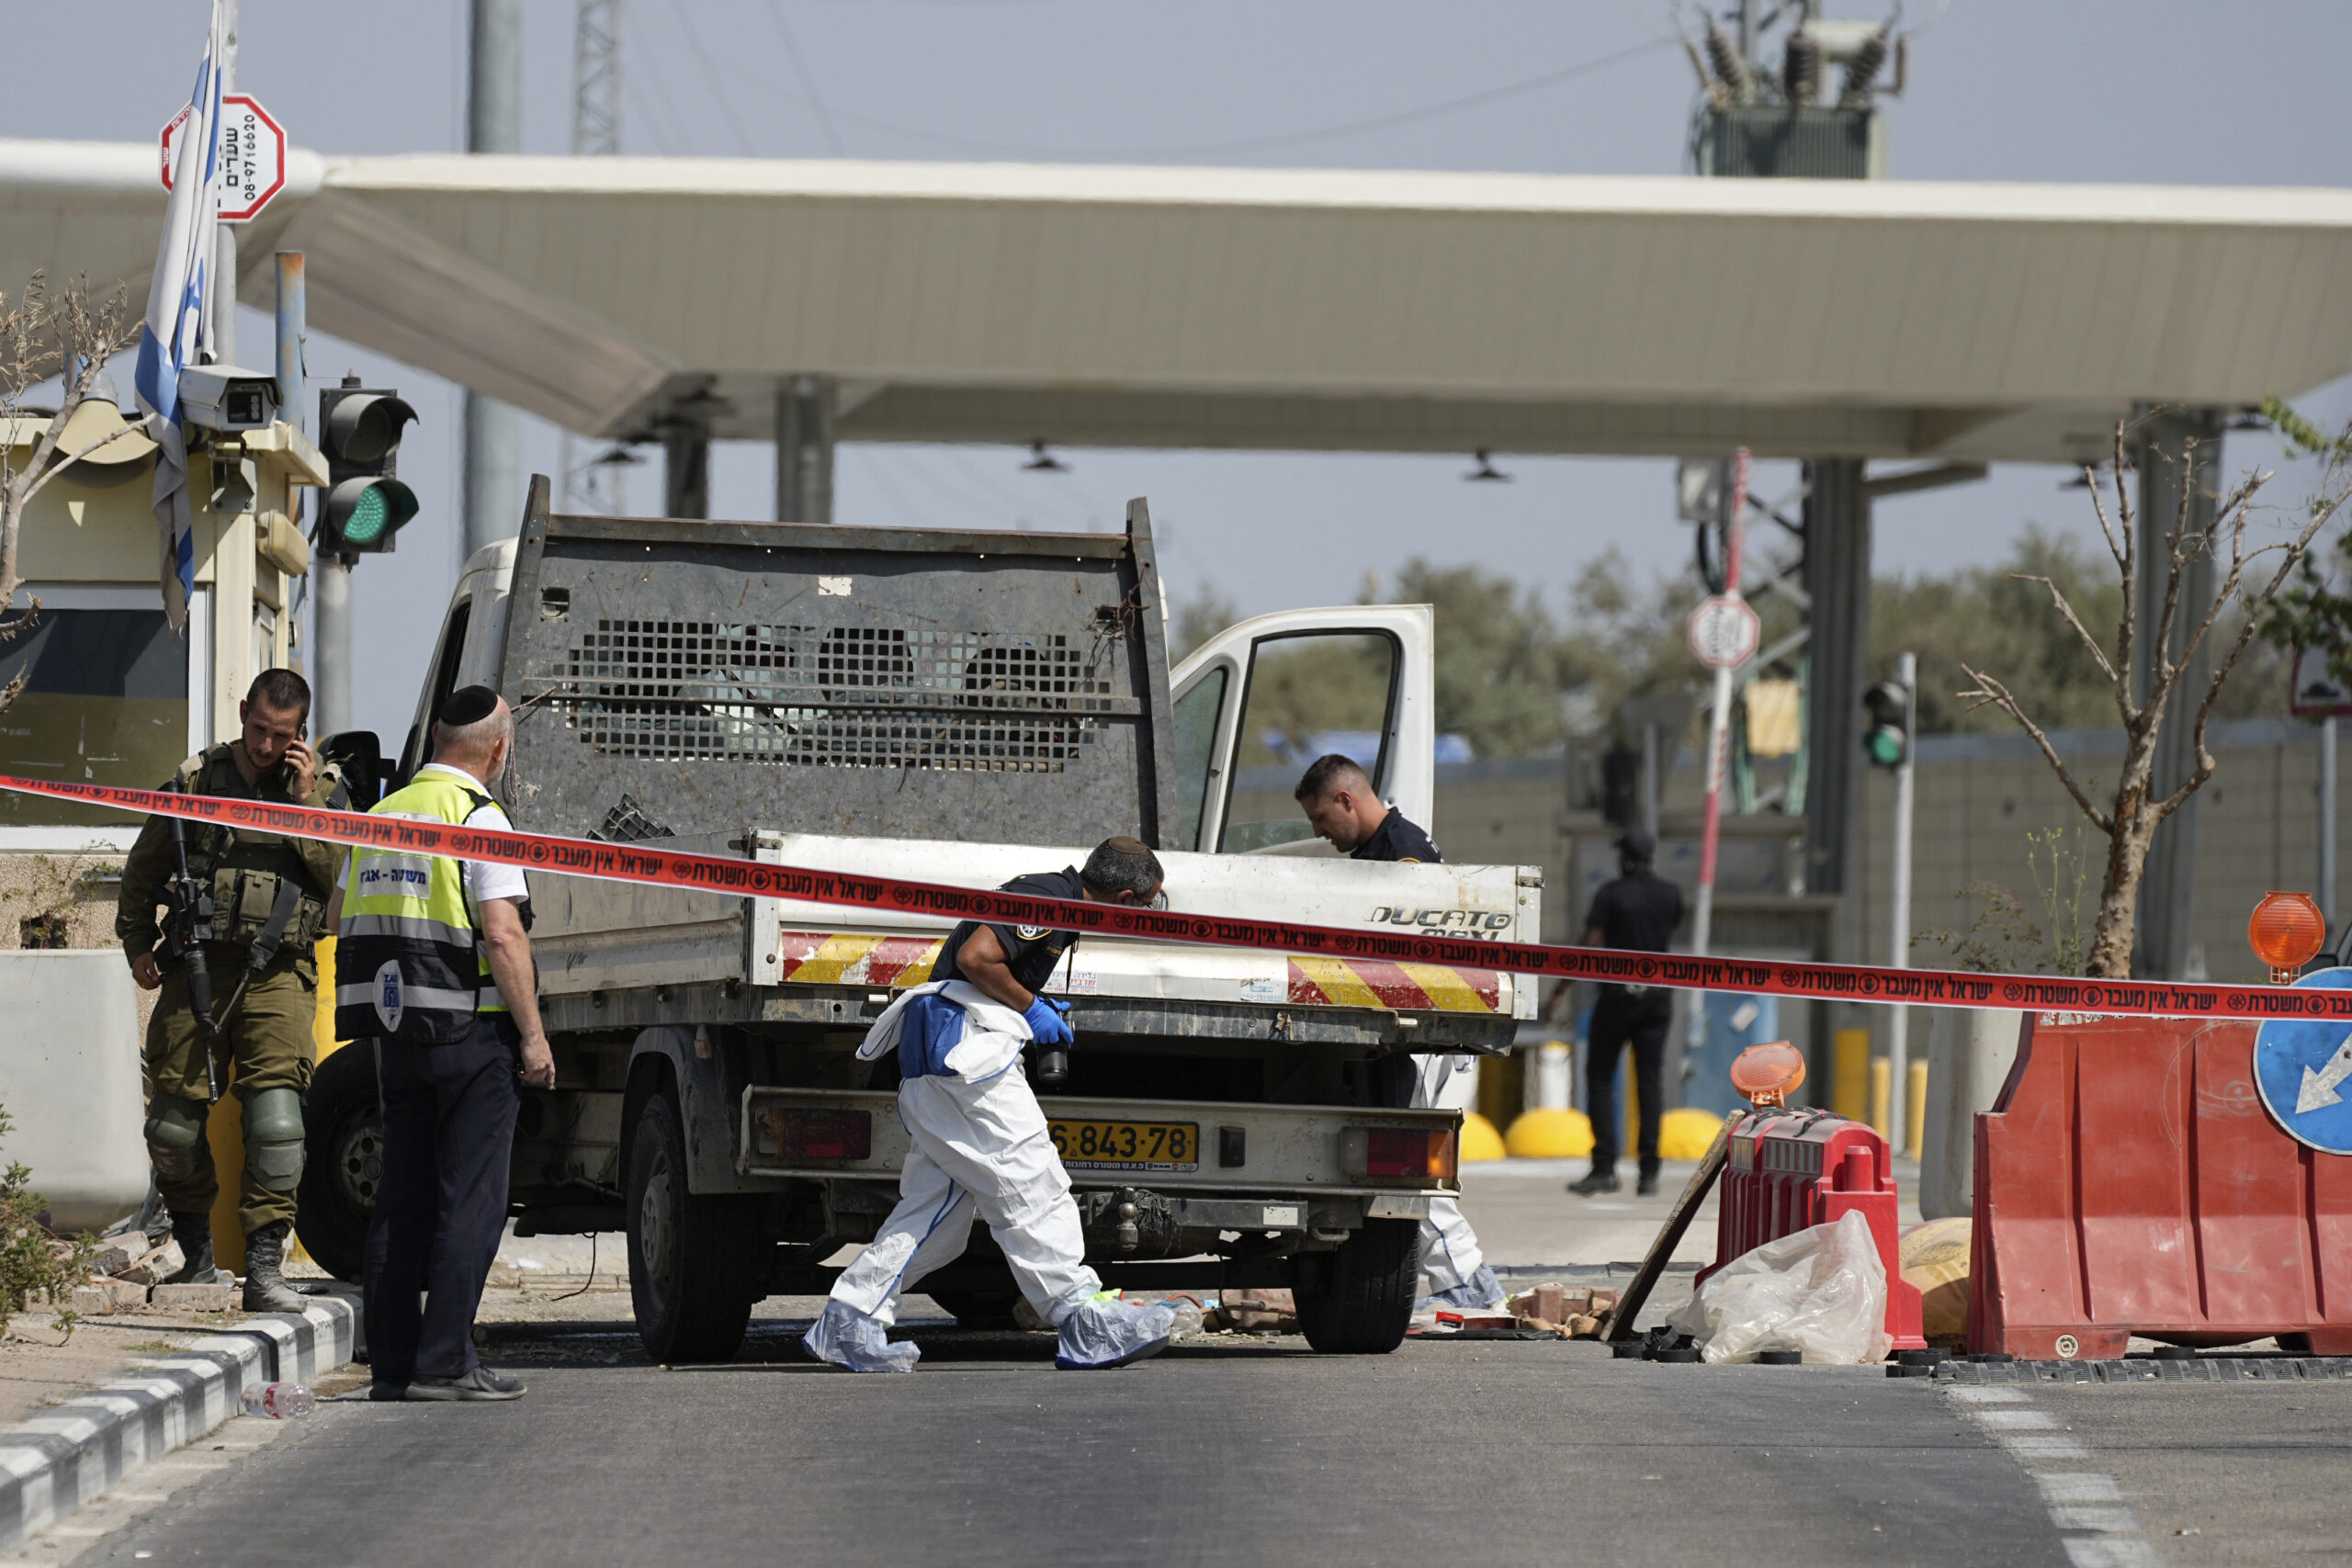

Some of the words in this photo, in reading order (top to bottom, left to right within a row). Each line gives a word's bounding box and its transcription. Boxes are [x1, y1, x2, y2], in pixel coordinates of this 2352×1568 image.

[226, 128, 239, 186] שערים
[243, 114, 255, 200] 08-9716620
[153, 791, 175, 811] אין
[175, 790, 220, 817] ישראל
[250, 809, 307, 831] משטרת
[329, 817, 369, 839] מעבר
[371, 821, 394, 843] אין
[395, 819, 441, 850] ישראל
[469, 837, 526, 861] משטרת
[549, 844, 590, 870] מעבר
[594, 849, 615, 874] אין
[616, 849, 662, 877] ישראל
[692, 862, 747, 888] משטרת
[773, 871, 812, 896] מעבר
[814, 875, 833, 899] אין
[837, 874, 883, 903] ישראל
[913, 887, 968, 913] משטרת
[992, 896, 1033, 919] מעבר
[1035, 901, 1055, 924] אין
[1058, 901, 1104, 927] ישראל
[1365, 906, 1514, 930] DUCATO
[1135, 913, 1189, 936] משטרת
[1213, 922, 1253, 942] מעבר
[1256, 927, 1276, 946] אין
[1280, 926, 1326, 950] ישראל
[1357, 936, 1411, 956] משטרת
[1436, 942, 1476, 963] מעבר
[1478, 946, 1500, 967] אין
[1502, 943, 1549, 969] ישראל
[1579, 954, 1634, 978] משטרת
[1658, 959, 1699, 981] מעבר
[1701, 964, 1722, 987] אין
[1724, 960, 1771, 987] ישראל
[1802, 969, 1856, 992] משטרת
[1882, 975, 1921, 996] מעבר
[1924, 977, 1944, 1000] אין
[1948, 975, 1993, 1001] ישראל
[2023, 984, 2079, 1005] משטרת
[2103, 988, 2144, 1009] מעבר
[2147, 991, 2169, 1012] אין
[2171, 987, 2218, 1011] ישראל
[2247, 995, 2303, 1014] משטרת
[1065, 1160, 1092, 1168] רחובות
[1093, 1161, 1121, 1169] מוטורס
